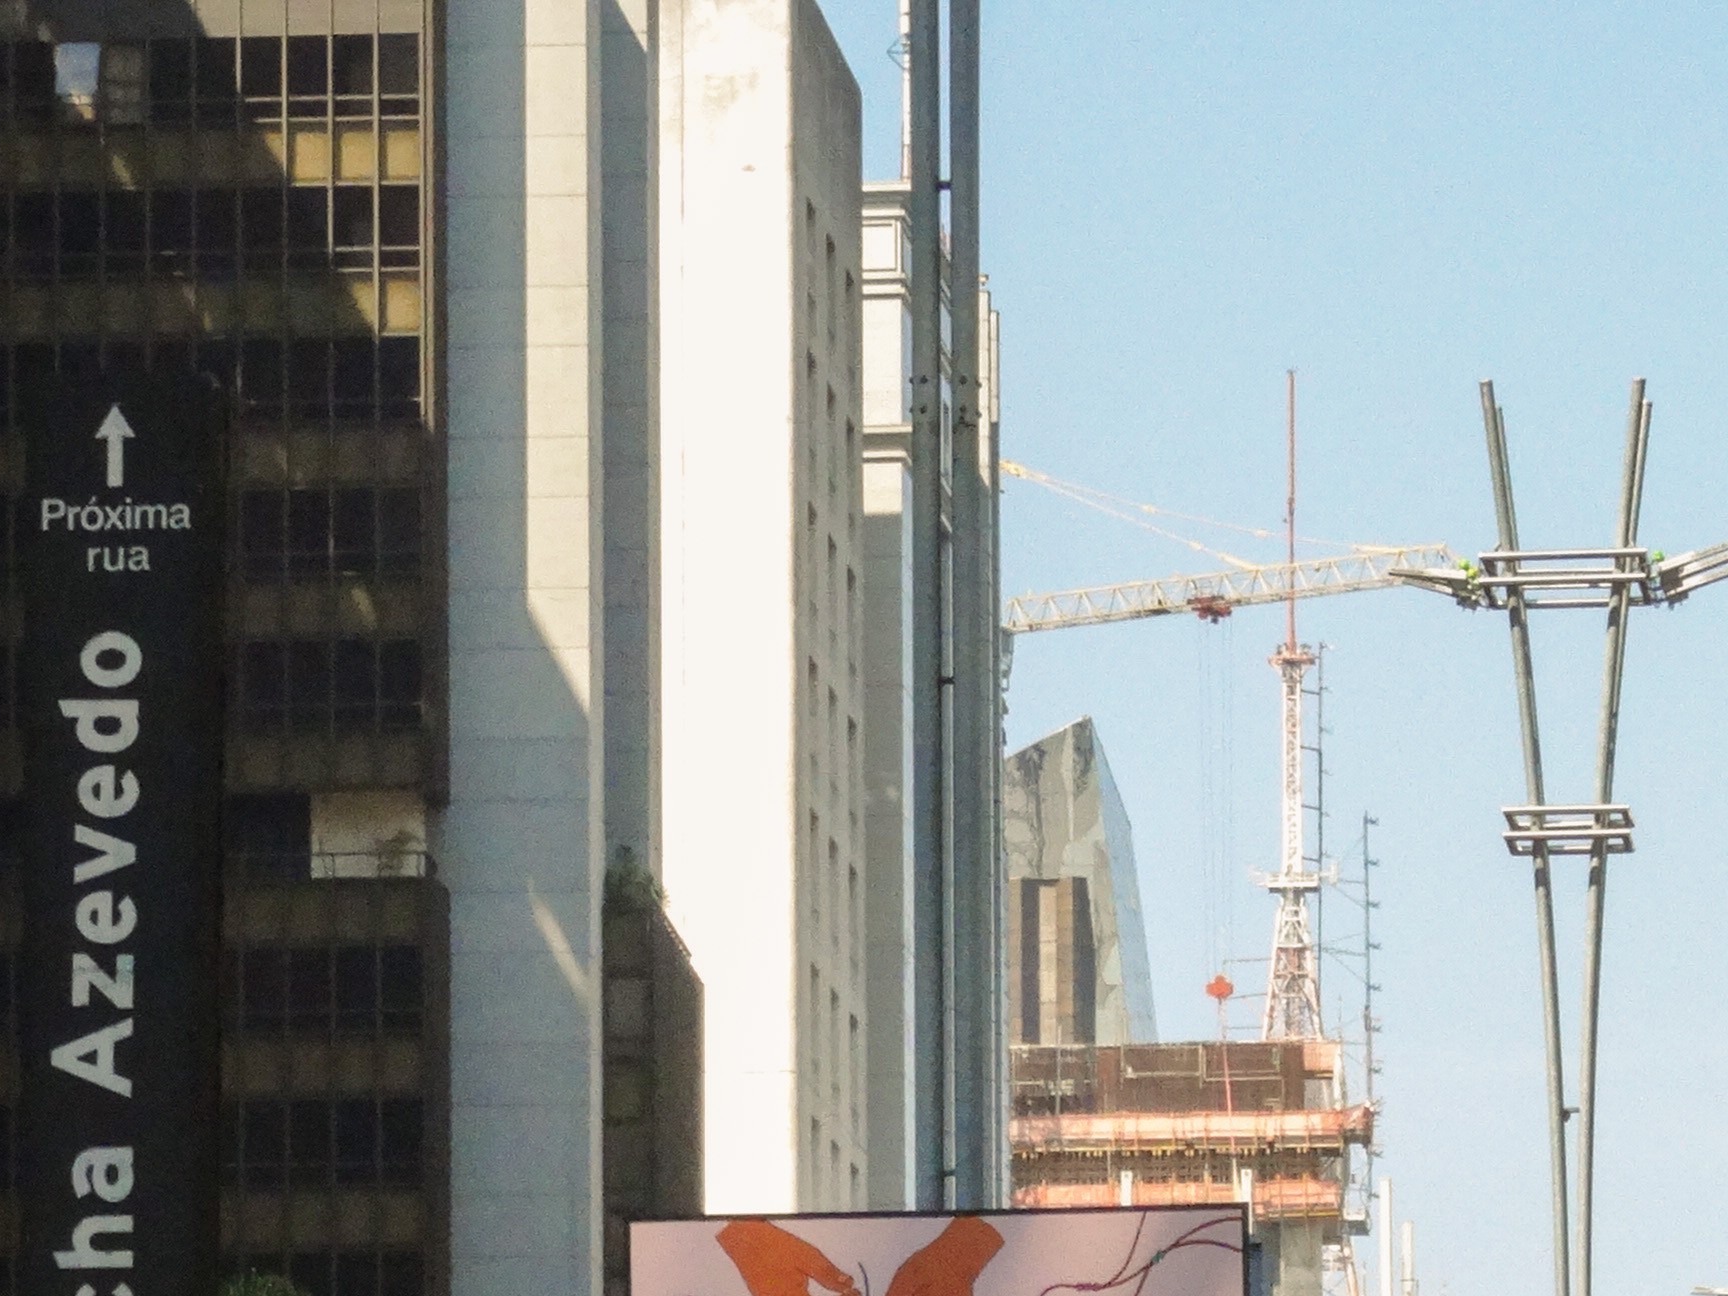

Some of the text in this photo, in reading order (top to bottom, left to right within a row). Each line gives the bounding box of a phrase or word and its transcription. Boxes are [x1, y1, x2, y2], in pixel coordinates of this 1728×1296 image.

[40, 496, 192, 533] Próxima
[85, 542, 152, 573] rua
[49, 629, 144, 1099] Azevedo
